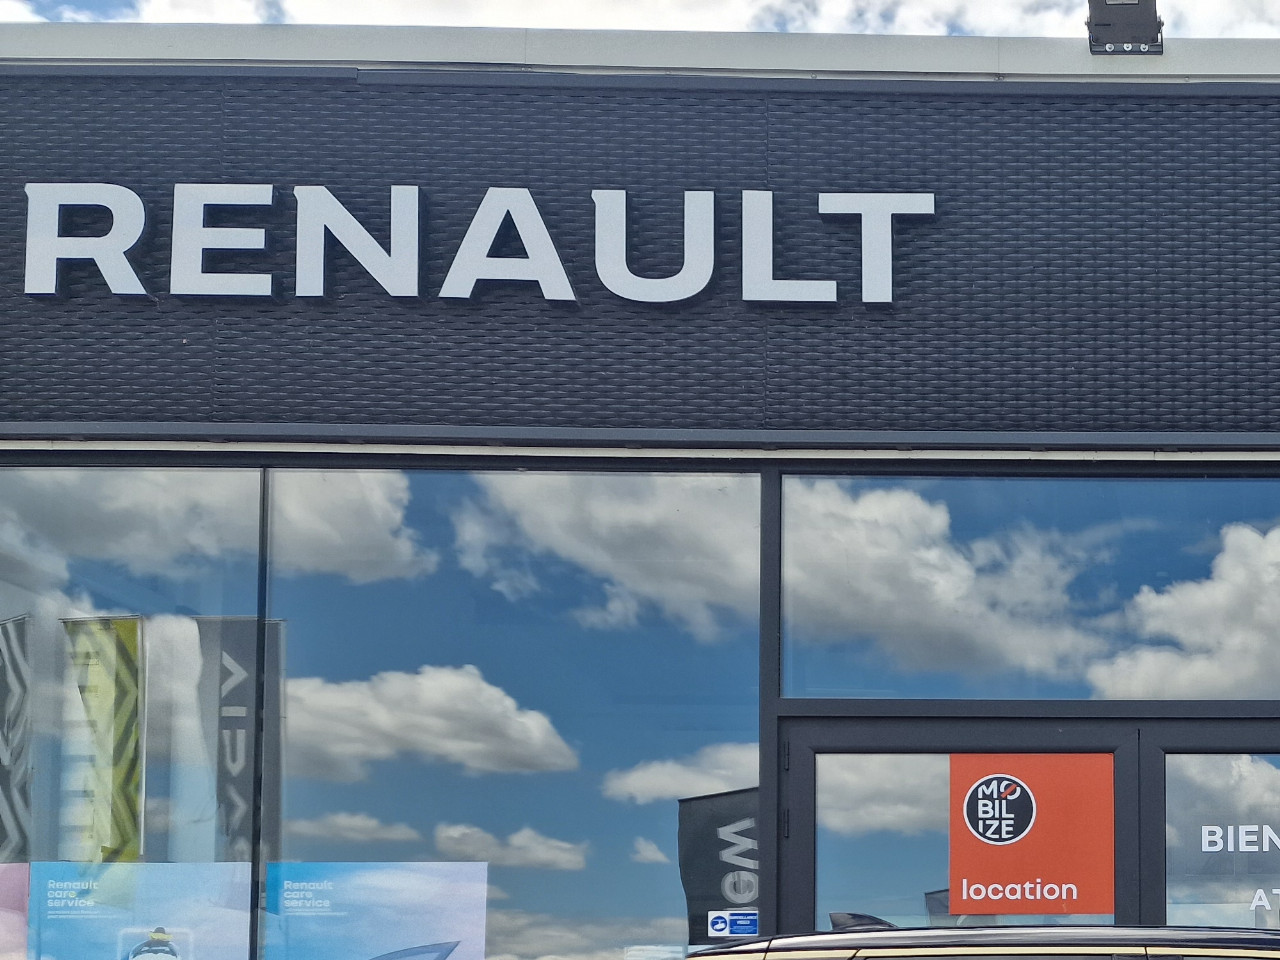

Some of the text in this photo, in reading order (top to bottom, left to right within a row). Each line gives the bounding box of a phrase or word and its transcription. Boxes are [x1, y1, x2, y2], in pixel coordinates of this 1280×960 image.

[24, 182, 935, 303] RENAULT
[48, 880, 99, 890] Renault
[284, 880, 334, 890] Renault
[961, 878, 1078, 900] location
[48, 890, 77, 898] care
[284, 890, 313, 898] care
[47, 898, 95, 907] service
[284, 898, 330, 907] service
